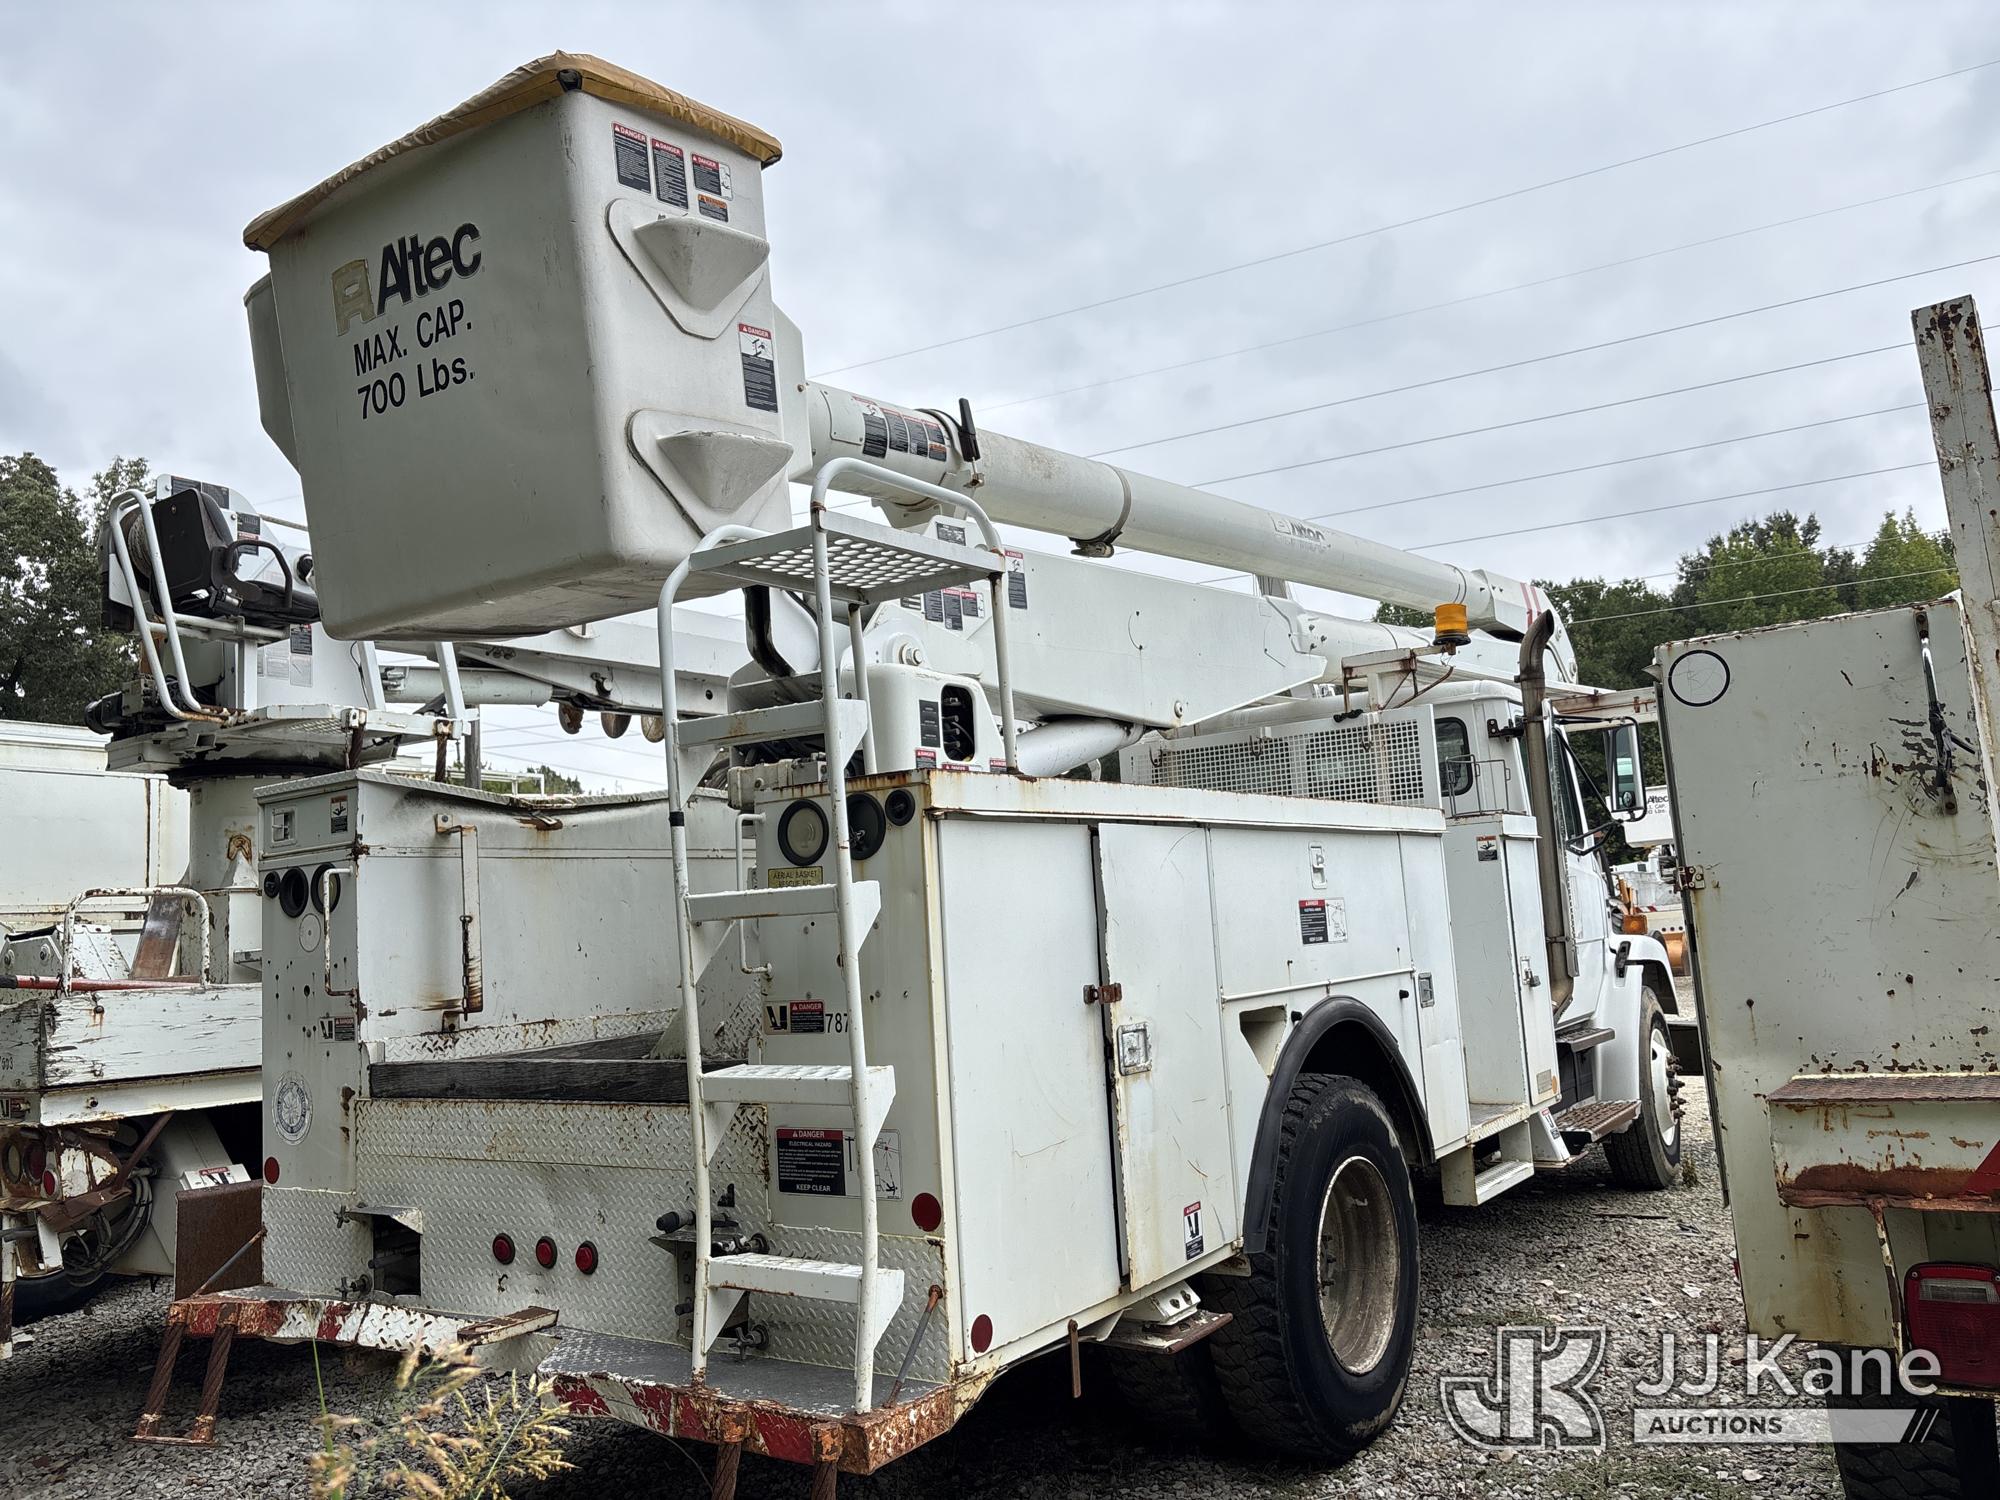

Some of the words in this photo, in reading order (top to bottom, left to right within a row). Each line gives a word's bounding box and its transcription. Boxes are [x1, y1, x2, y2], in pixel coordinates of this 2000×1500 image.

[619, 126, 646, 143] DANGER
[353, 325, 408, 377] MAX.
[416, 298, 472, 349] CAP.
[357, 371, 406, 420] 700
[416, 356, 474, 398] Lbs.
[795, 870, 817, 878] BASKET
[798, 1131, 825, 1139] DANGER
[811, 1184, 831, 1192] CLEAR
